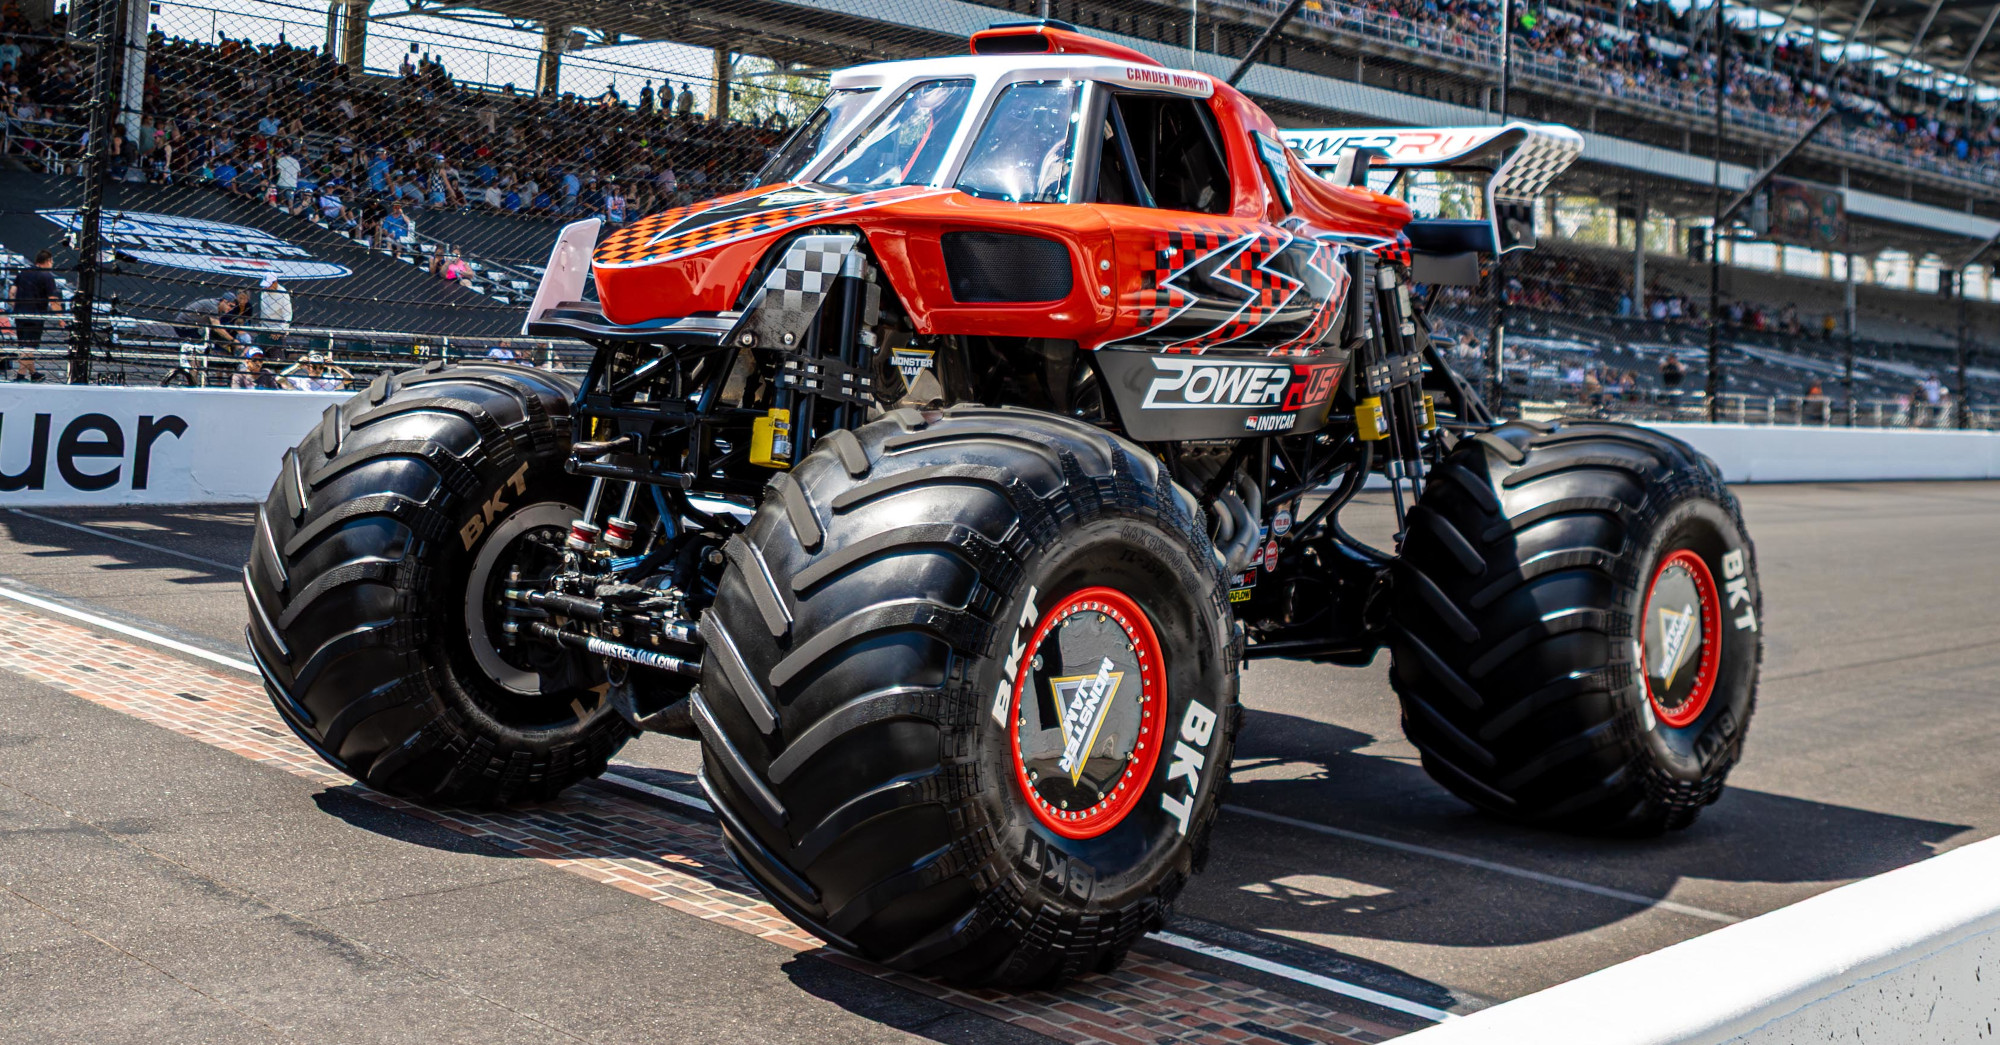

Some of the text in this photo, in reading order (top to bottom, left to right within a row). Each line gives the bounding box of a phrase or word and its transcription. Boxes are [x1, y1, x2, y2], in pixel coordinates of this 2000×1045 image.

[1126, 67, 1209, 92] CAMDEN MURPHY
[891, 356, 934, 368] MONSTER
[902, 366, 921, 376] JAM
[1142, 357, 1344, 411] POWER RUSH
[1256, 413, 1297, 431] INDYCAR
[459, 461, 529, 551] BKT
[1722, 549, 1758, 633] BKT
[588, 638, 679, 672] MONSTERJAM.COM
[992, 585, 1039, 729] BKT
[1057, 657, 1115, 773] MONSTER
[1062, 678, 1088, 734] JAM
[1160, 699, 1217, 836] BKT
[1023, 834, 1095, 897] BKT
